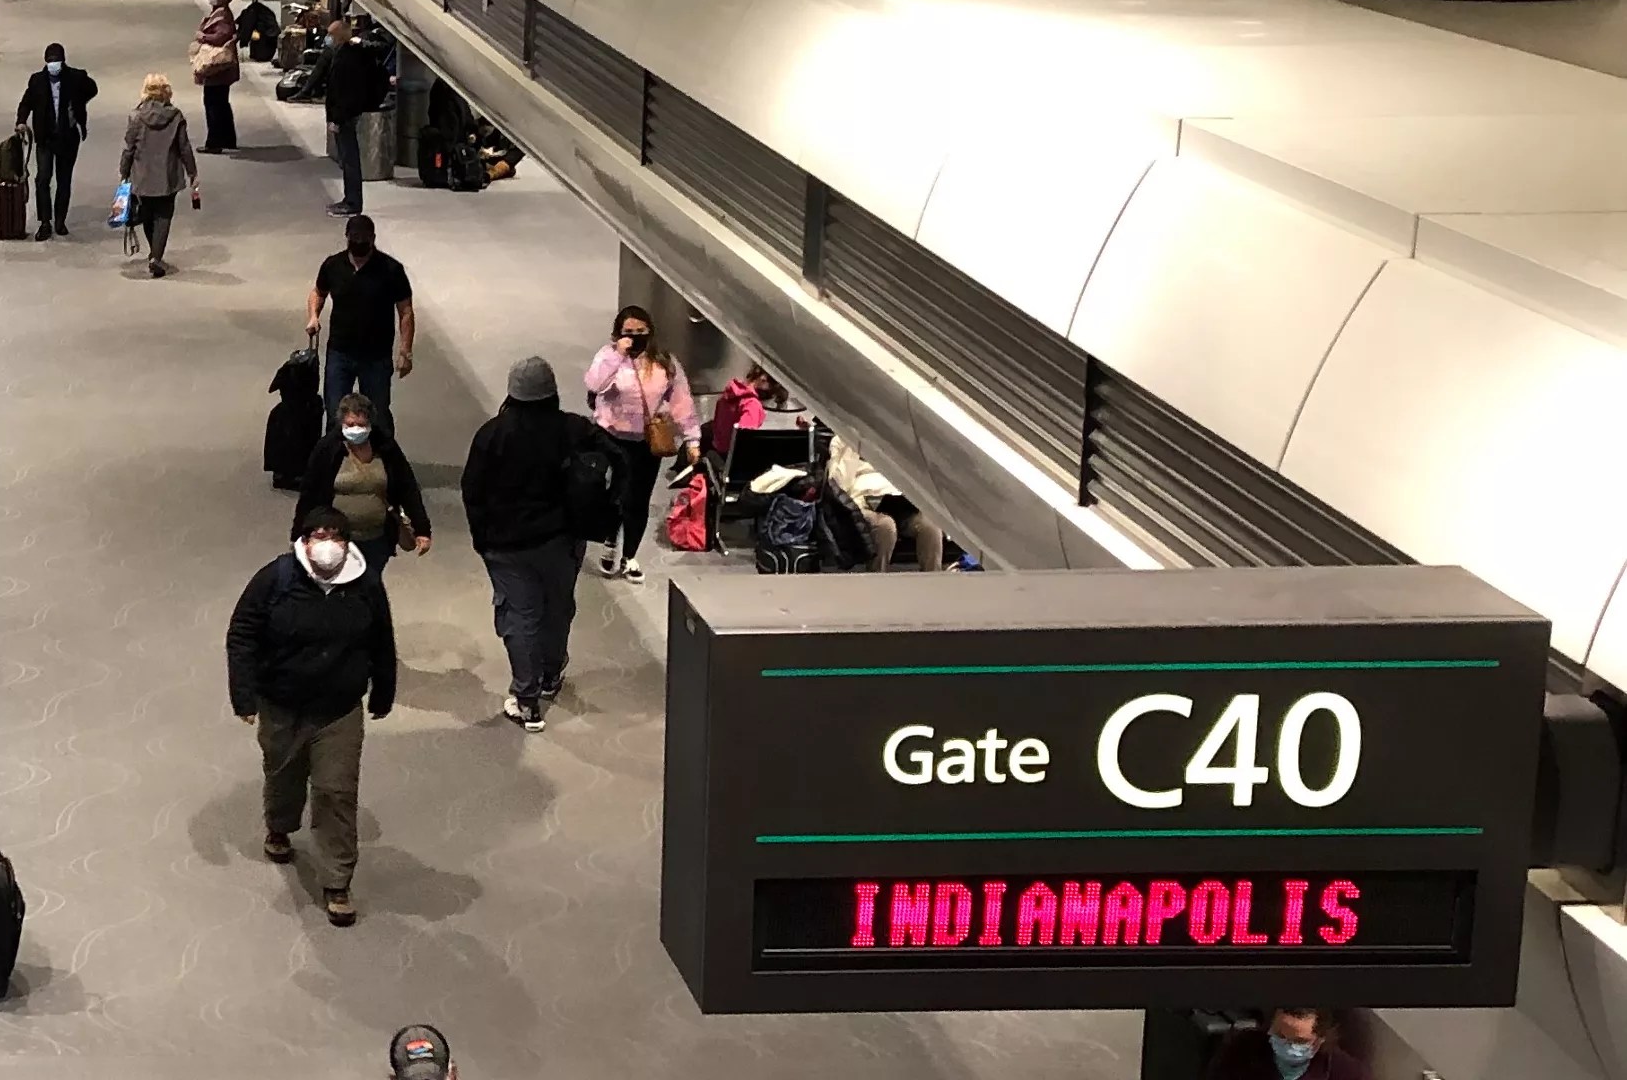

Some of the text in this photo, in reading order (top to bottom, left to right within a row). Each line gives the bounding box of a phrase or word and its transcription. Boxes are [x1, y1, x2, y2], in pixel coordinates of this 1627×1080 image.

[883, 691, 1362, 809] Gate C40
[851, 880, 1361, 947] INDIANAPOLIS
